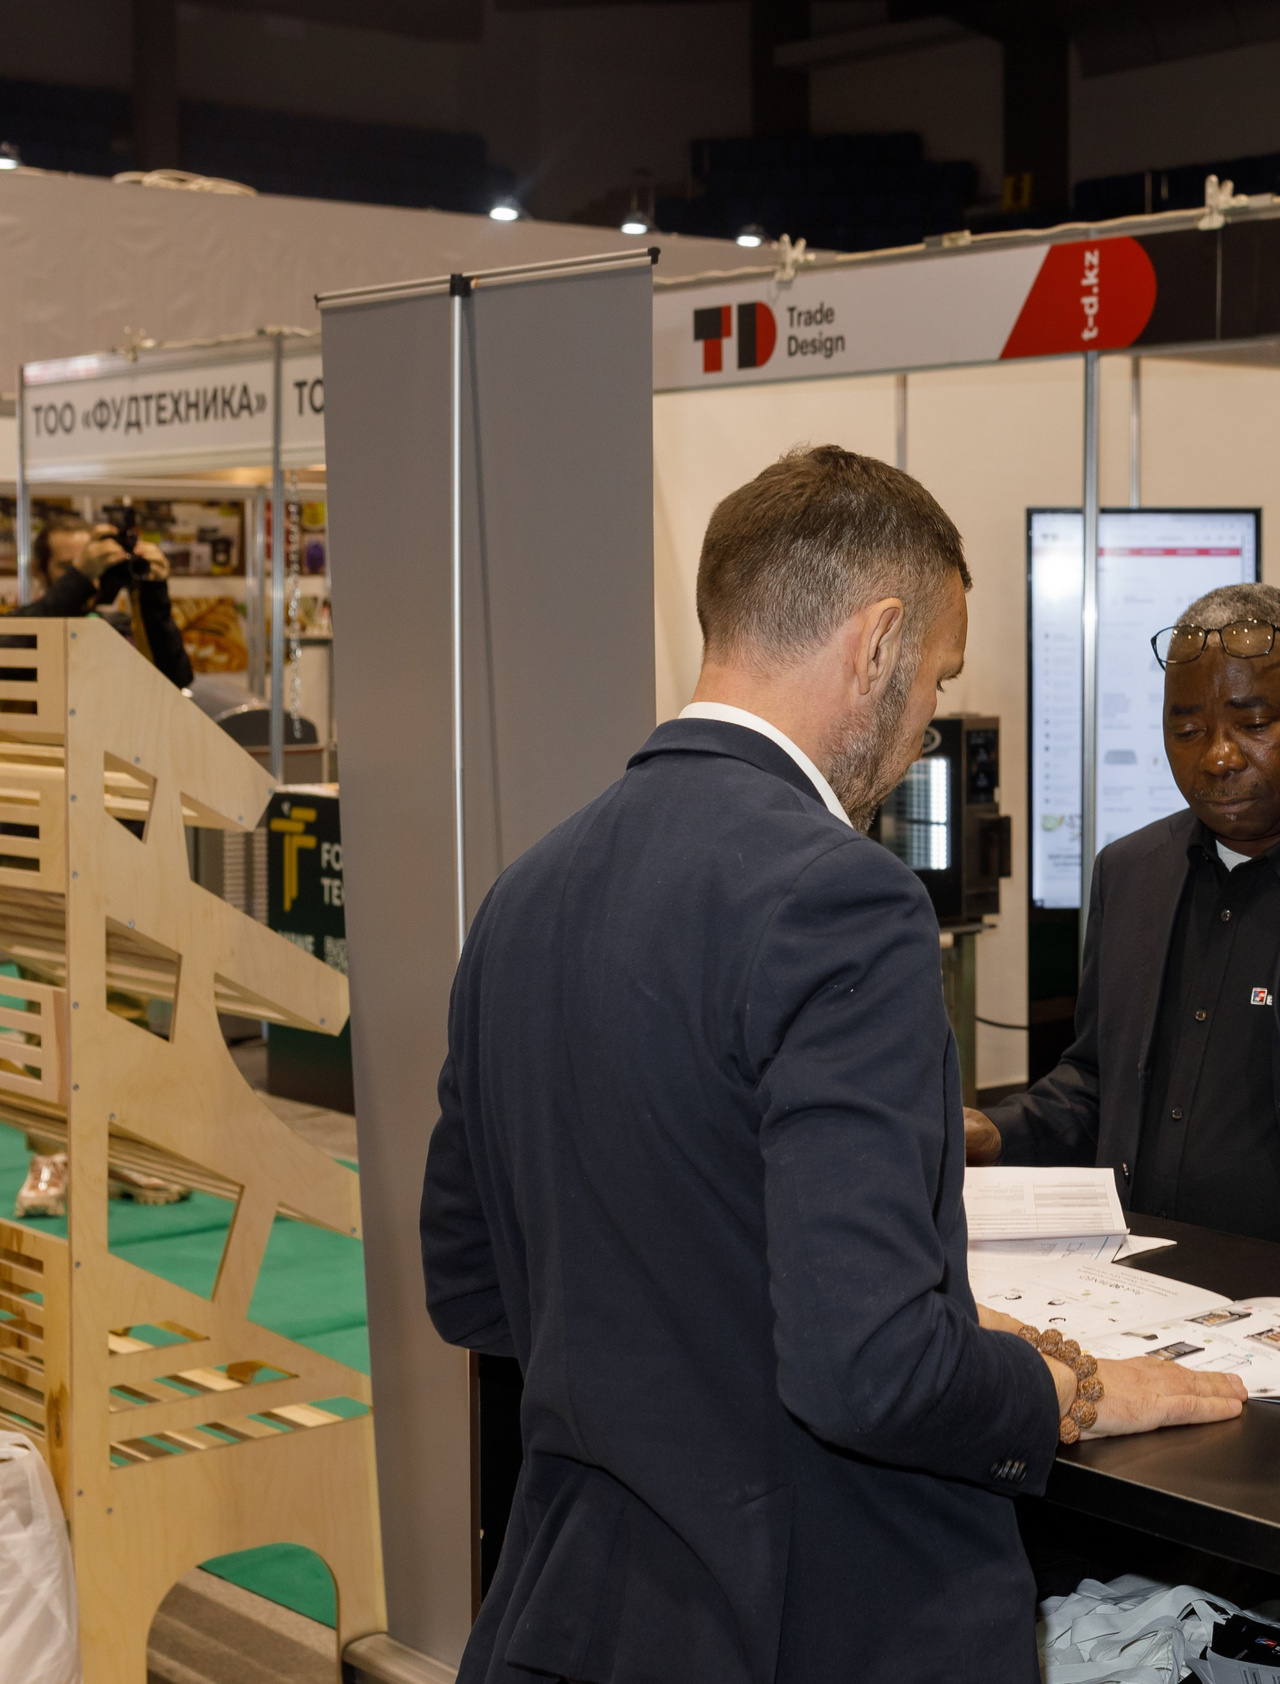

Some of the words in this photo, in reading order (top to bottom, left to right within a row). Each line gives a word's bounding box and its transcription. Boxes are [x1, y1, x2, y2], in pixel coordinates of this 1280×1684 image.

[1081, 249, 1100, 341] t-d.kz
[787, 303, 835, 330] Trade
[787, 333, 846, 360] Design
[32, 402, 76, 436] ТОО
[82, 384, 267, 436] «ФУДТЕХНИКА»
[321, 877, 345, 907] TE
